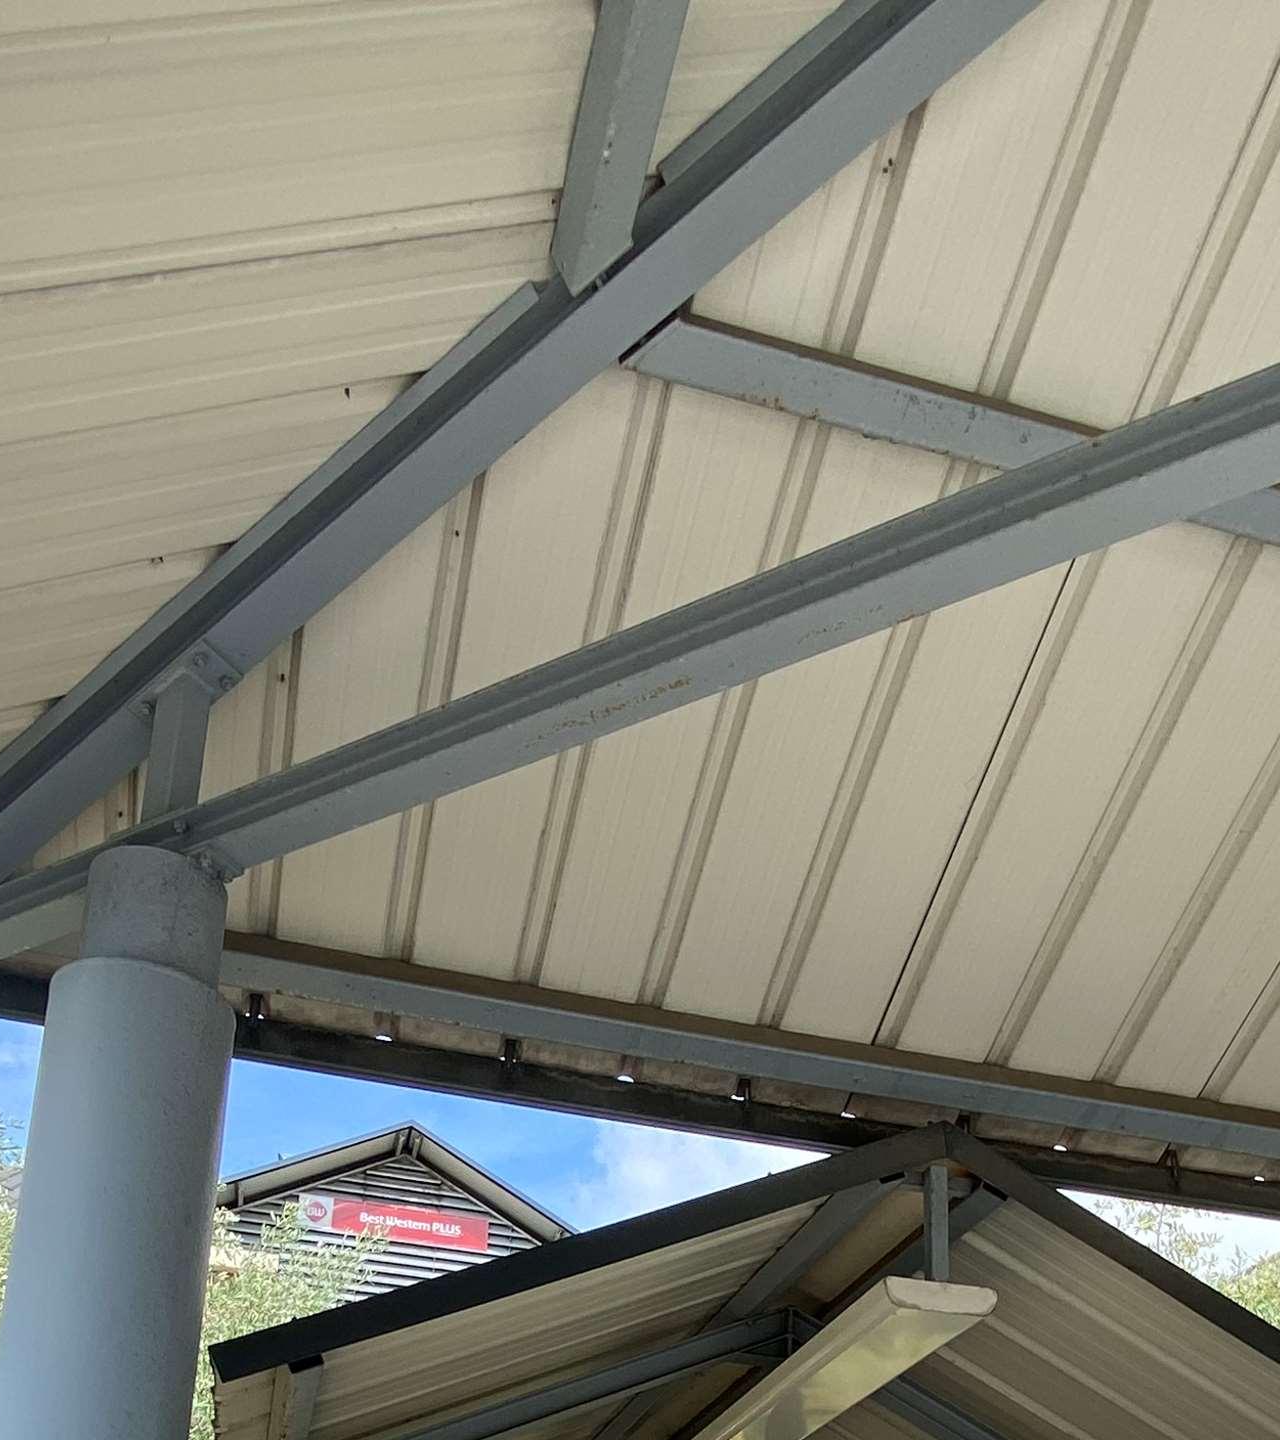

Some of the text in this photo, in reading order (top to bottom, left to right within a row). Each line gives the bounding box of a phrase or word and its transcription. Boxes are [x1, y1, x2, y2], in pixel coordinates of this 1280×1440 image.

[359, 1211, 462, 1236] Best Western PLUS
